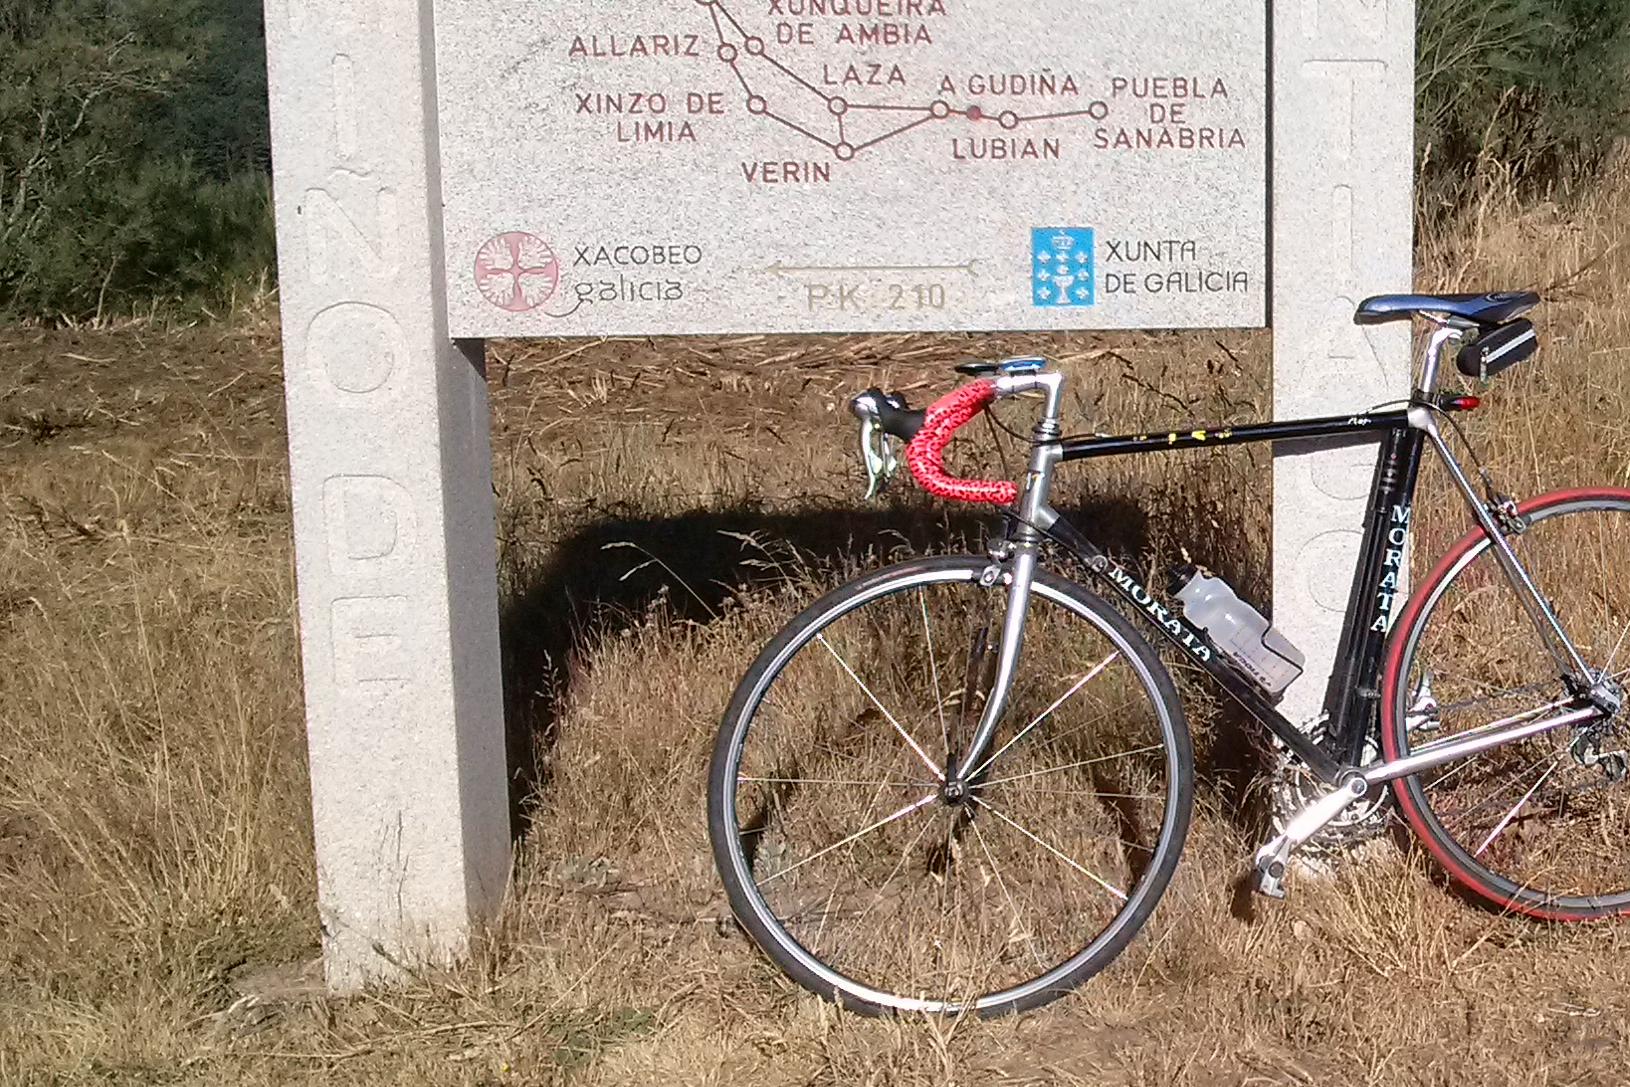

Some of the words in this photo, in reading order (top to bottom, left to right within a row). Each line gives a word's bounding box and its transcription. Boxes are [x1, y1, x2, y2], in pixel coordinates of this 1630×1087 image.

[768, 0, 947, 16] XUNQUEIRA
[776, 23, 814, 45] DE
[836, 24, 932, 44] AMBIA
[569, 35, 700, 57] ALLARIZ
[823, 64, 906, 86] LAZA
[938, 75, 956, 96] A
[968, 67, 1079, 96] GUDIÑA
[1111, 78, 1228, 98] PUEBLA
[575, 93, 667, 114] XINZO
[688, 93, 725, 114] DE
[1150, 104, 1186, 124] DE
[617, 121, 697, 142] LIMIA
[1094, 127, 1246, 149] SANABRIA
[952, 138, 1060, 160] LUBIAN
[742, 162, 831, 183] VERIN
[573, 246, 702, 267] XACOBEO
[1105, 241, 1197, 263] XUNTA
[1105, 273, 1137, 294] DE
[1144, 271, 1249, 294] GALICIA
[544, 274, 684, 317] galicia
[888, 283, 945, 311] 210
[1370, 504, 1410, 633] MORATA
[1107, 565, 1214, 663] MORATA
